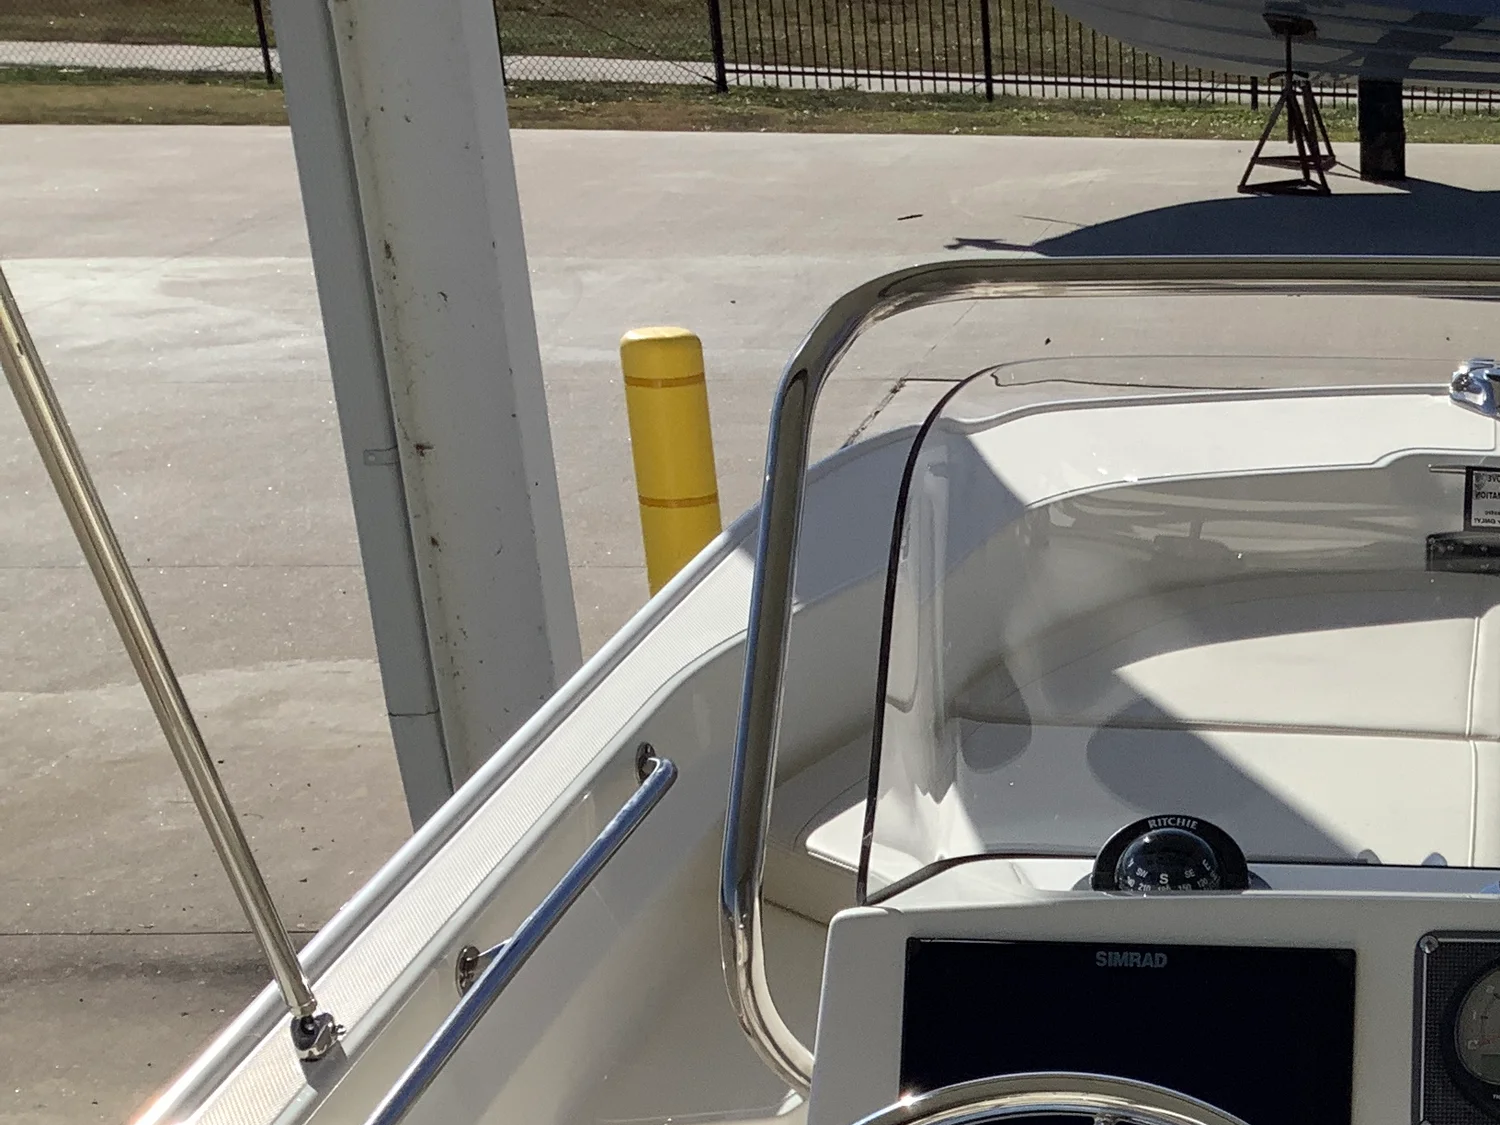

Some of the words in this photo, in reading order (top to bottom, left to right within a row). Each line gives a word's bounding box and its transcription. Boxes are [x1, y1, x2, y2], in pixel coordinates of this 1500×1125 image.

[1148, 817, 1198, 829] RITCHIE
[1159, 874, 1169, 885] S
[1095, 950, 1168, 968] SIMRAD
